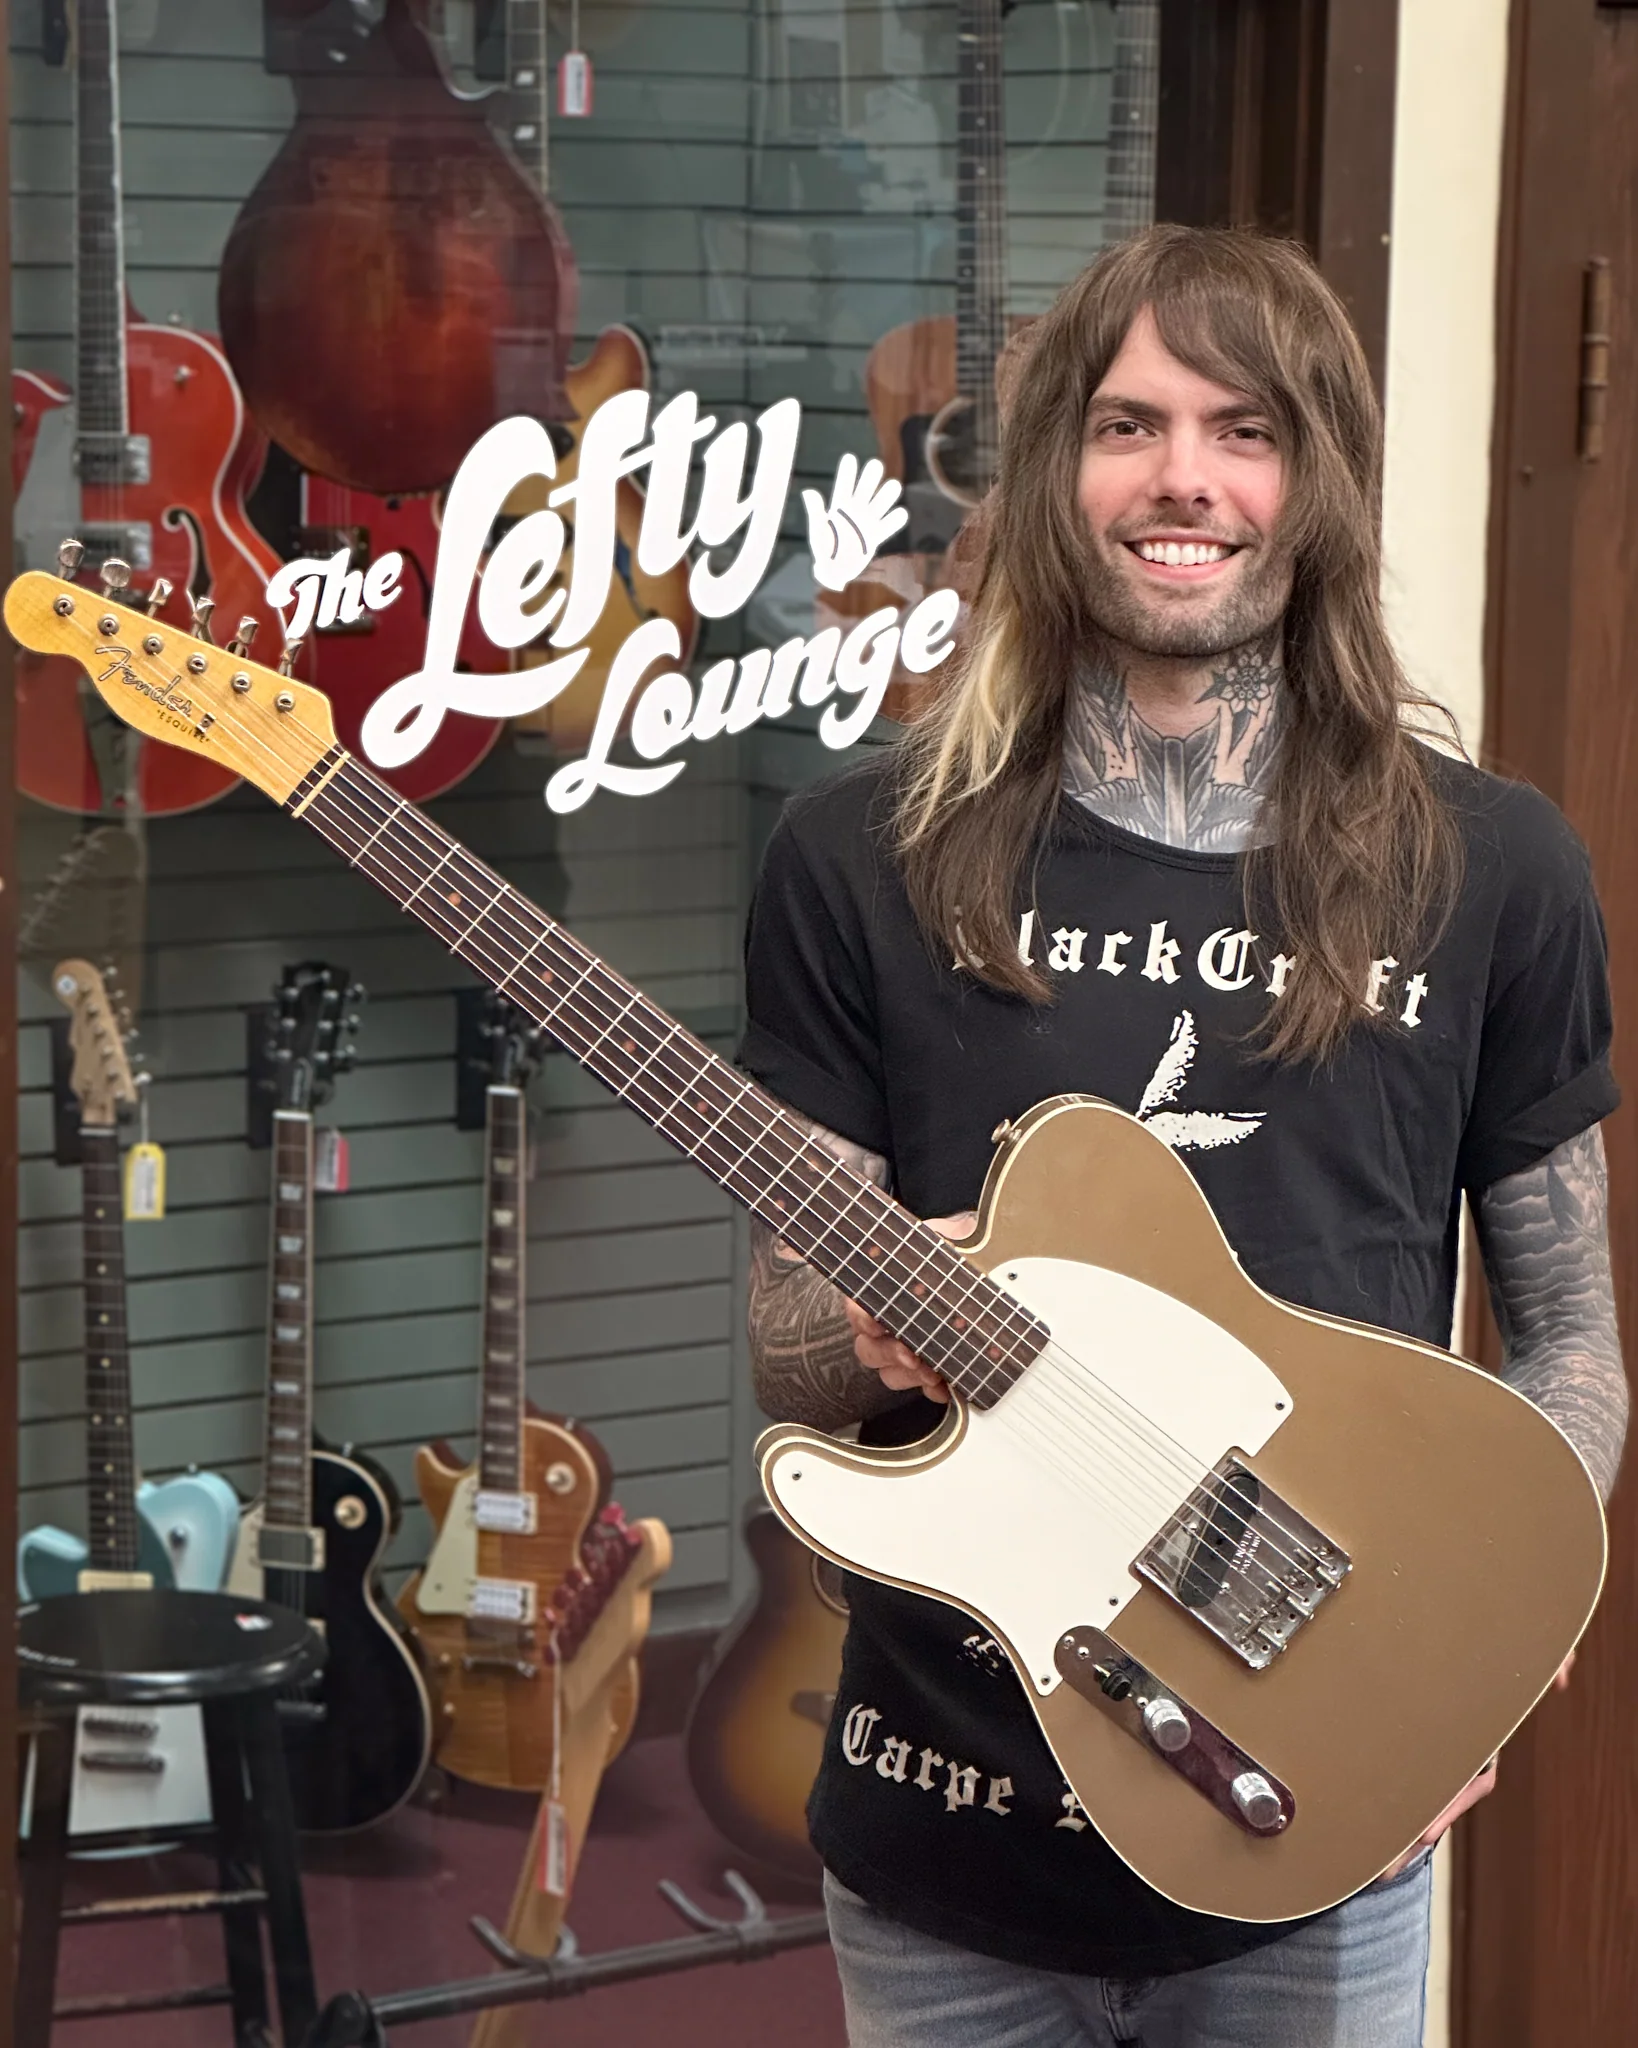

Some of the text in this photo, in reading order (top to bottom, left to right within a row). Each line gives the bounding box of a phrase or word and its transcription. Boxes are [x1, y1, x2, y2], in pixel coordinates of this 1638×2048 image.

[266, 389, 800, 768] The Lefty
[95, 646, 191, 717] Fender
[546, 589, 960, 814] Lounge
[951, 904, 1429, 1029] lackCrft
[842, 1703, 1015, 1816] Carpe
